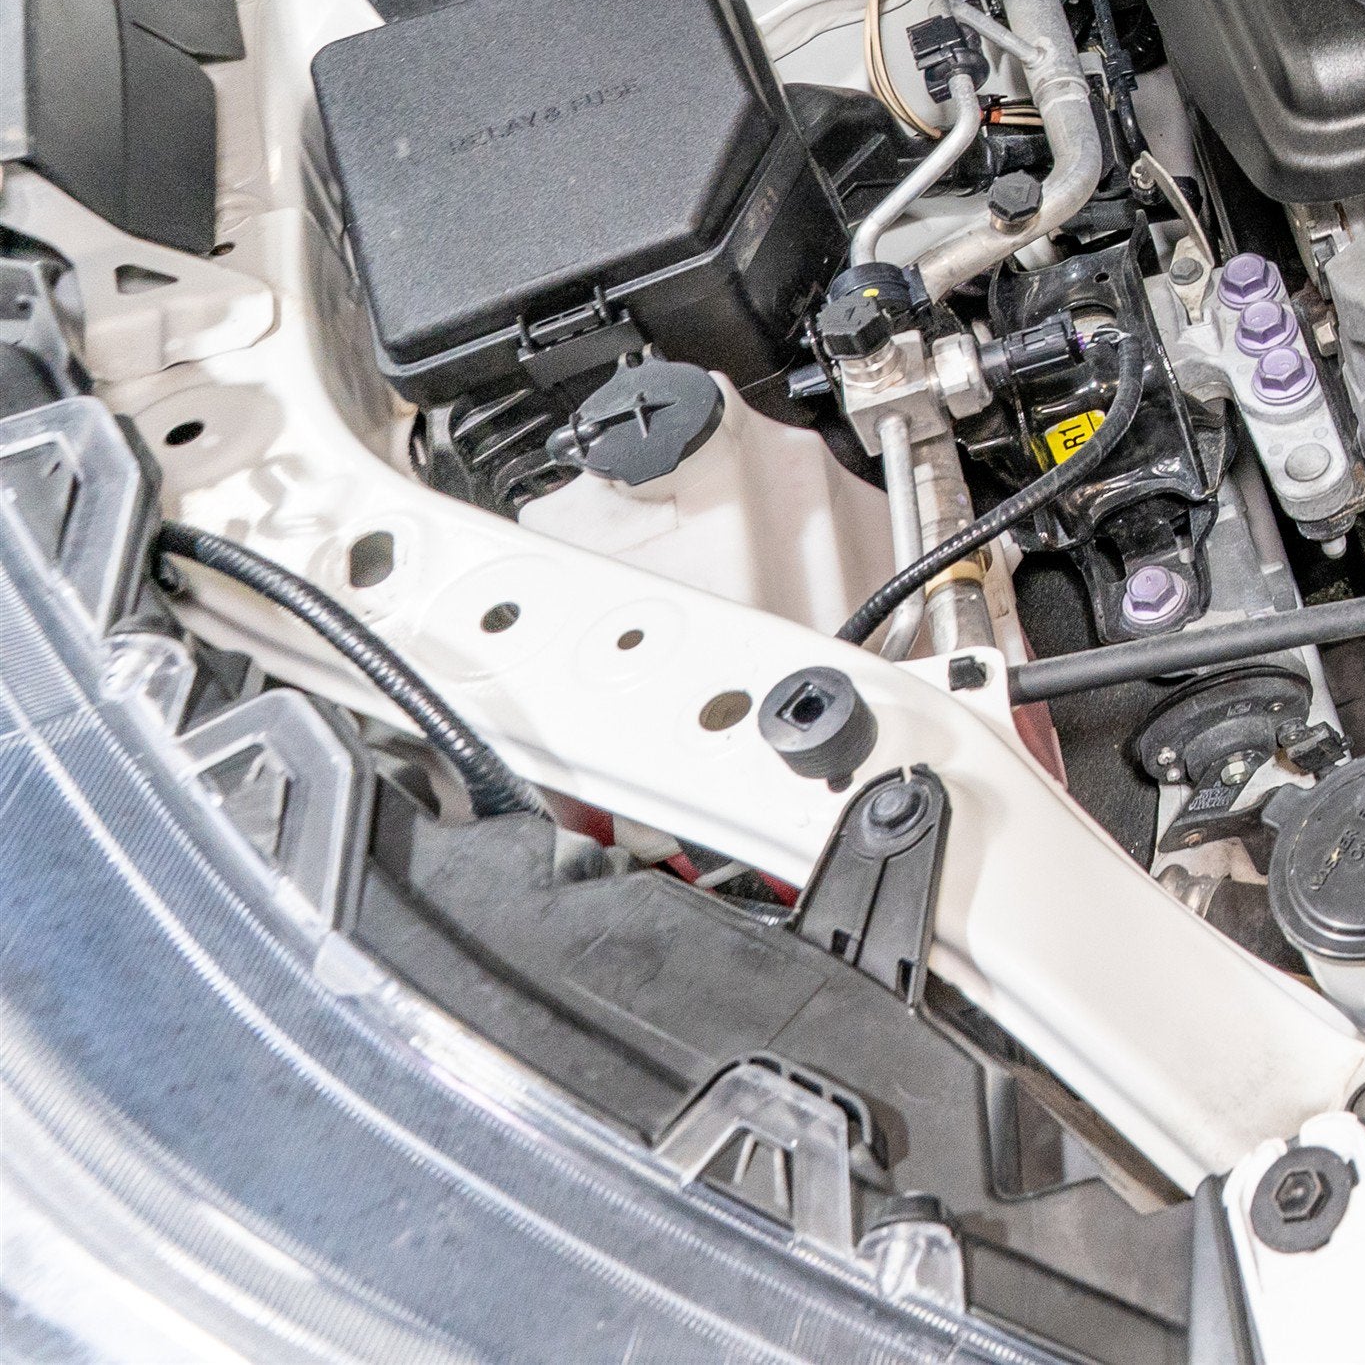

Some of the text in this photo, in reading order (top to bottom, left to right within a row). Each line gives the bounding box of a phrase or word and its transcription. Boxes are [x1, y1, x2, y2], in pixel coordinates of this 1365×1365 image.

[450, 112, 537, 154] RELAY
[1058, 424, 1088, 451] R1
[1309, 829, 1359, 891] WASHER
